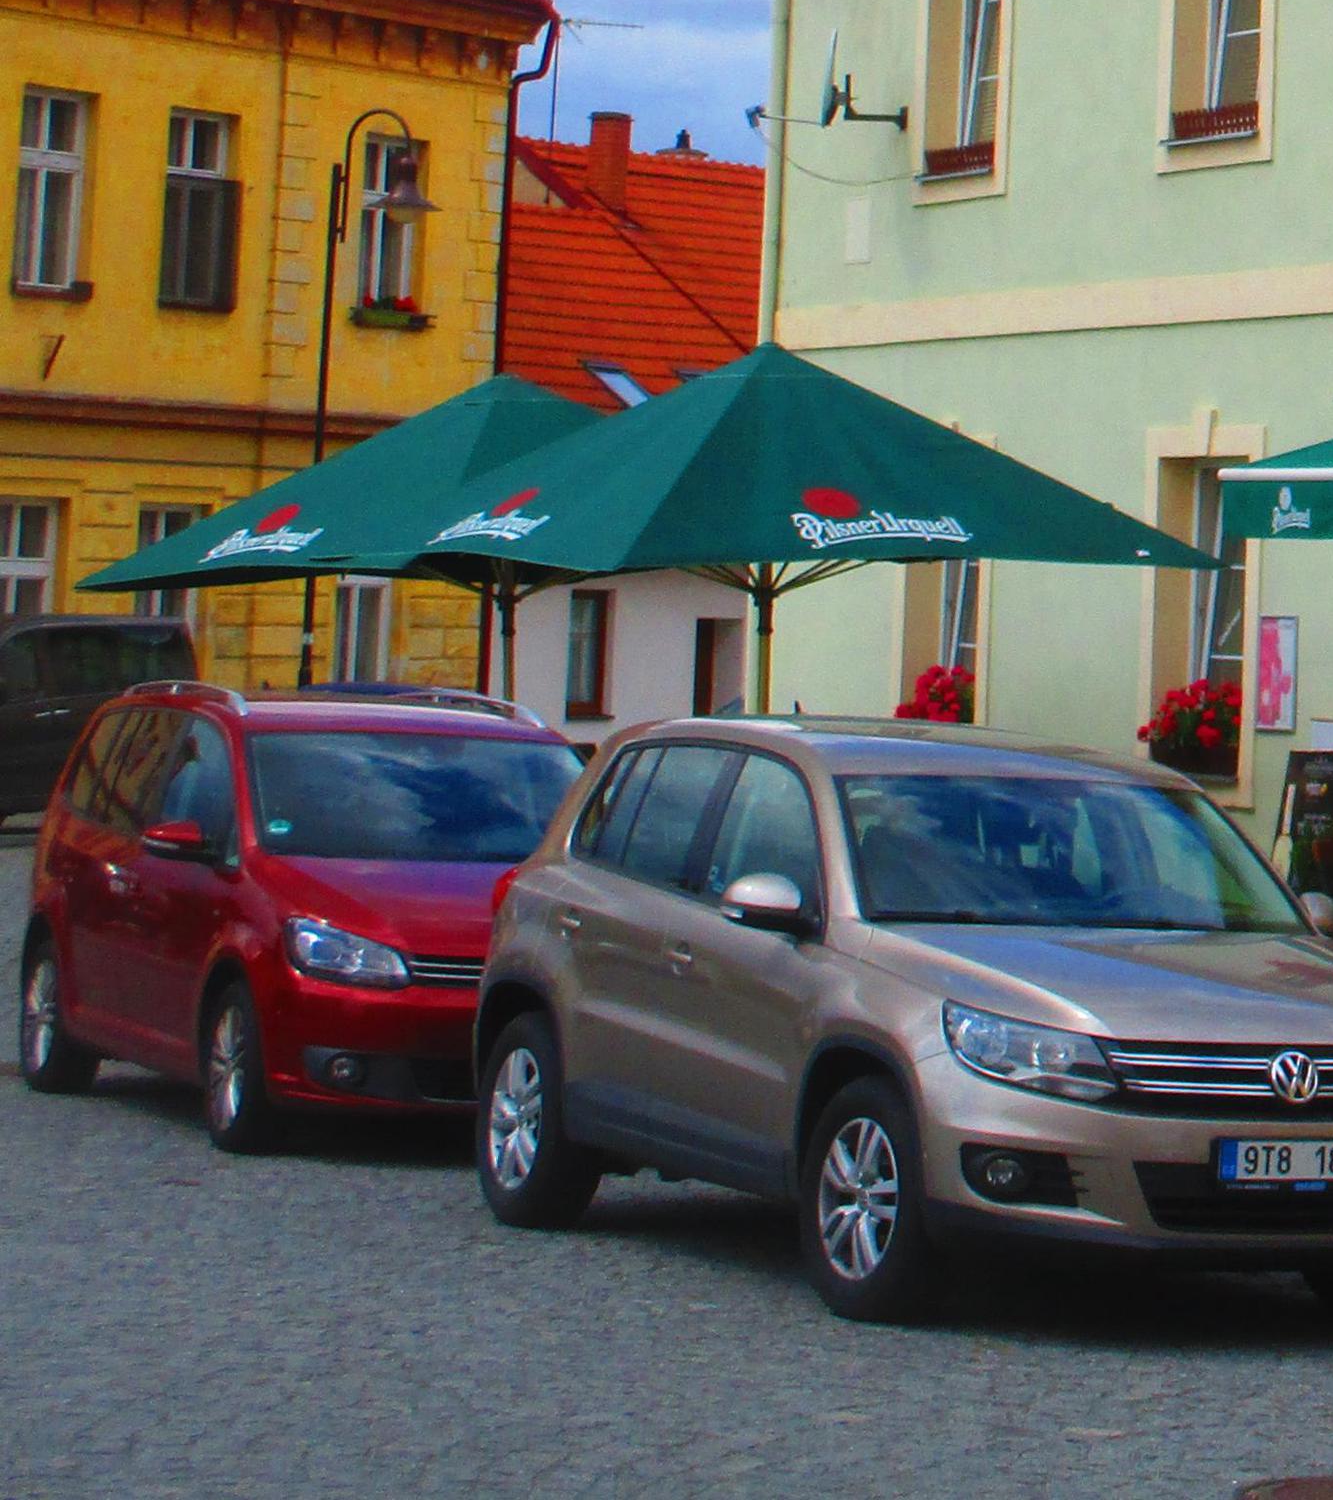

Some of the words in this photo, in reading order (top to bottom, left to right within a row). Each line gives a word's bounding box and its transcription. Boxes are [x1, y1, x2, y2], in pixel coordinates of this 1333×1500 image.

[790, 512, 881, 549] Pilsner
[869, 509, 973, 542] Urquell
[1243, 1145, 1292, 1176] 9T8
